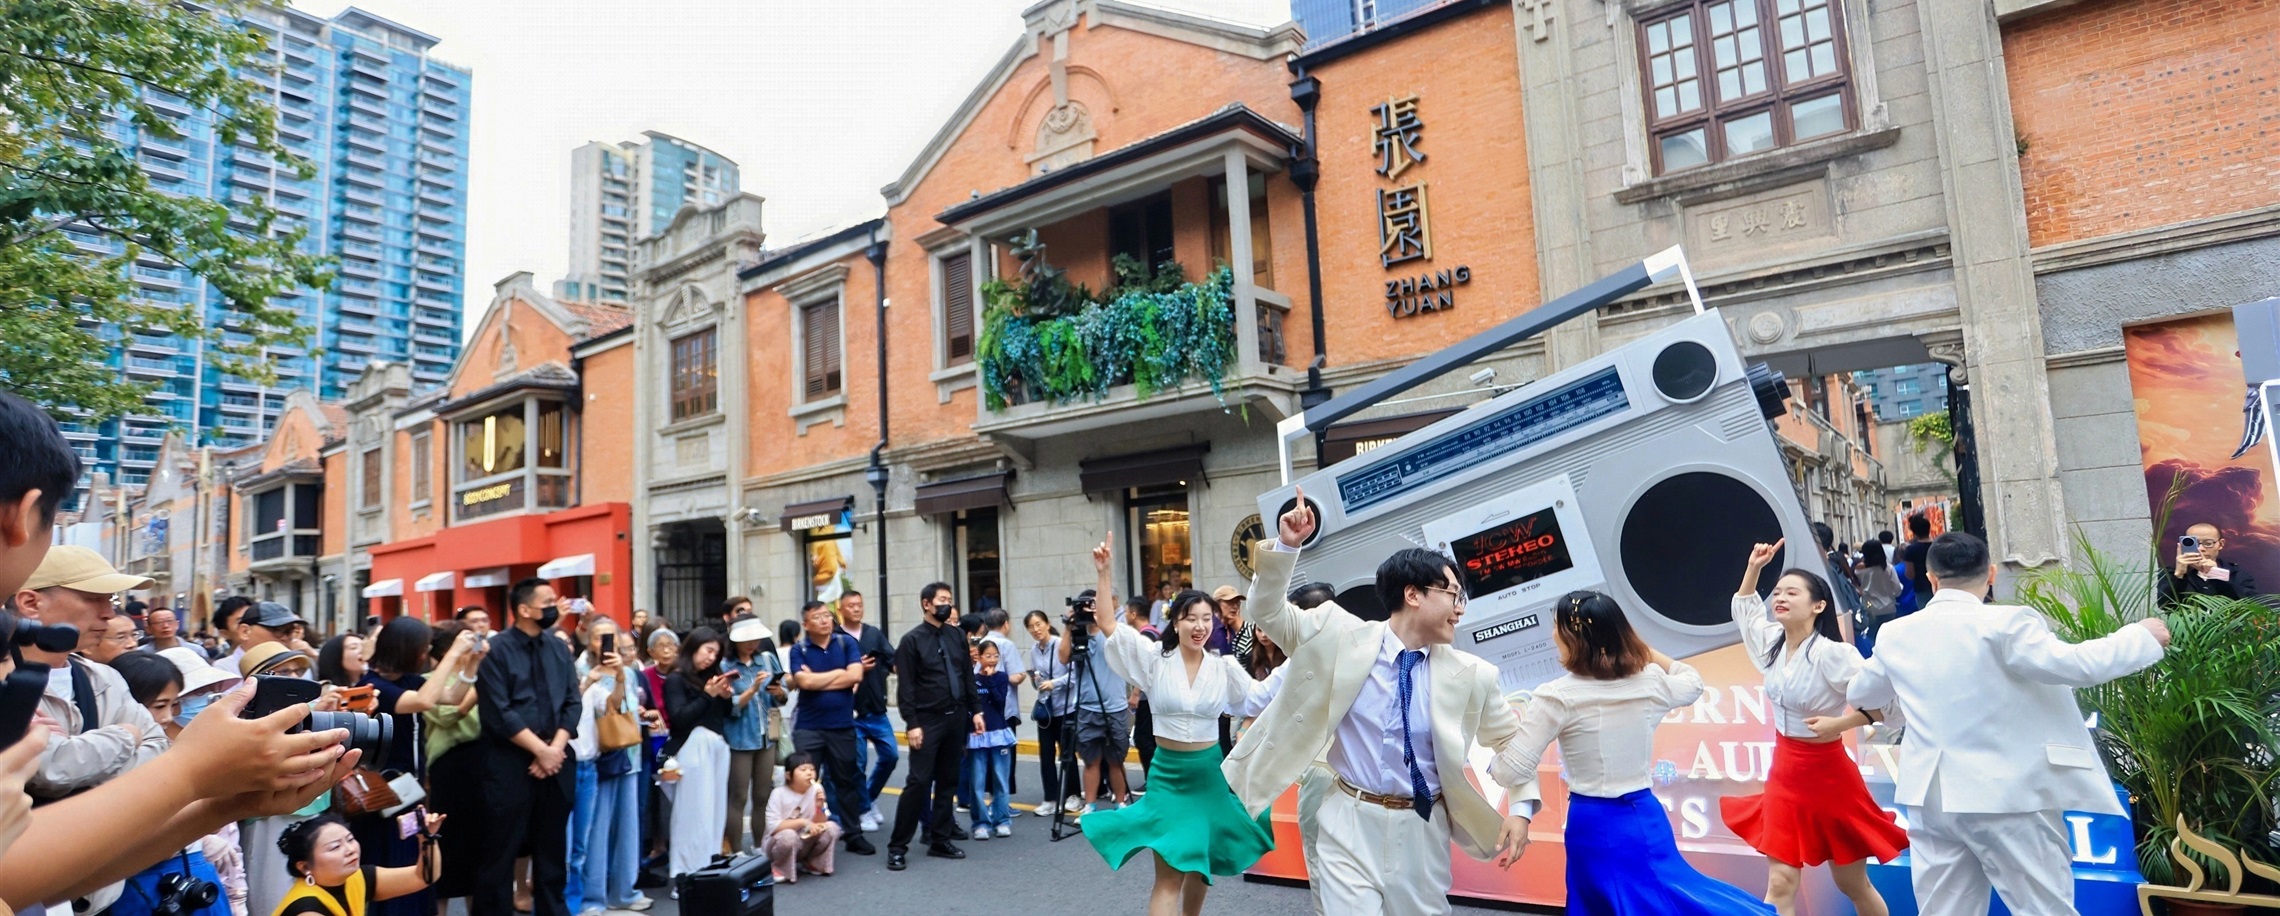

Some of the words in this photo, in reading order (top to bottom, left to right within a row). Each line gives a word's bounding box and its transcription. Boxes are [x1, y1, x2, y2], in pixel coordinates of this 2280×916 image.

[1370, 93, 1433, 270] 張園
[1385, 265, 1470, 299] ZHANG
[1386, 290, 1455, 319] YUAN
[1523, 408, 1532, 417] 100
[1535, 403, 1544, 412] 102
[1547, 398, 1557, 407] 104
[1560, 393, 1570, 402] 106
[1575, 387, 1585, 395] 108
[1356, 438, 1397, 456] BIR
[792, 513, 830, 531] BIRKENSTOCK
[1466, 534, 1555, 570] STEREO
[1498, 591, 1517, 601] AUTO
[1521, 583, 1541, 592] STOP
[1475, 616, 1537, 641] SHANGHAI
[1502, 649, 1521, 660] MODEL
[1524, 642, 1547, 653] L-2400
